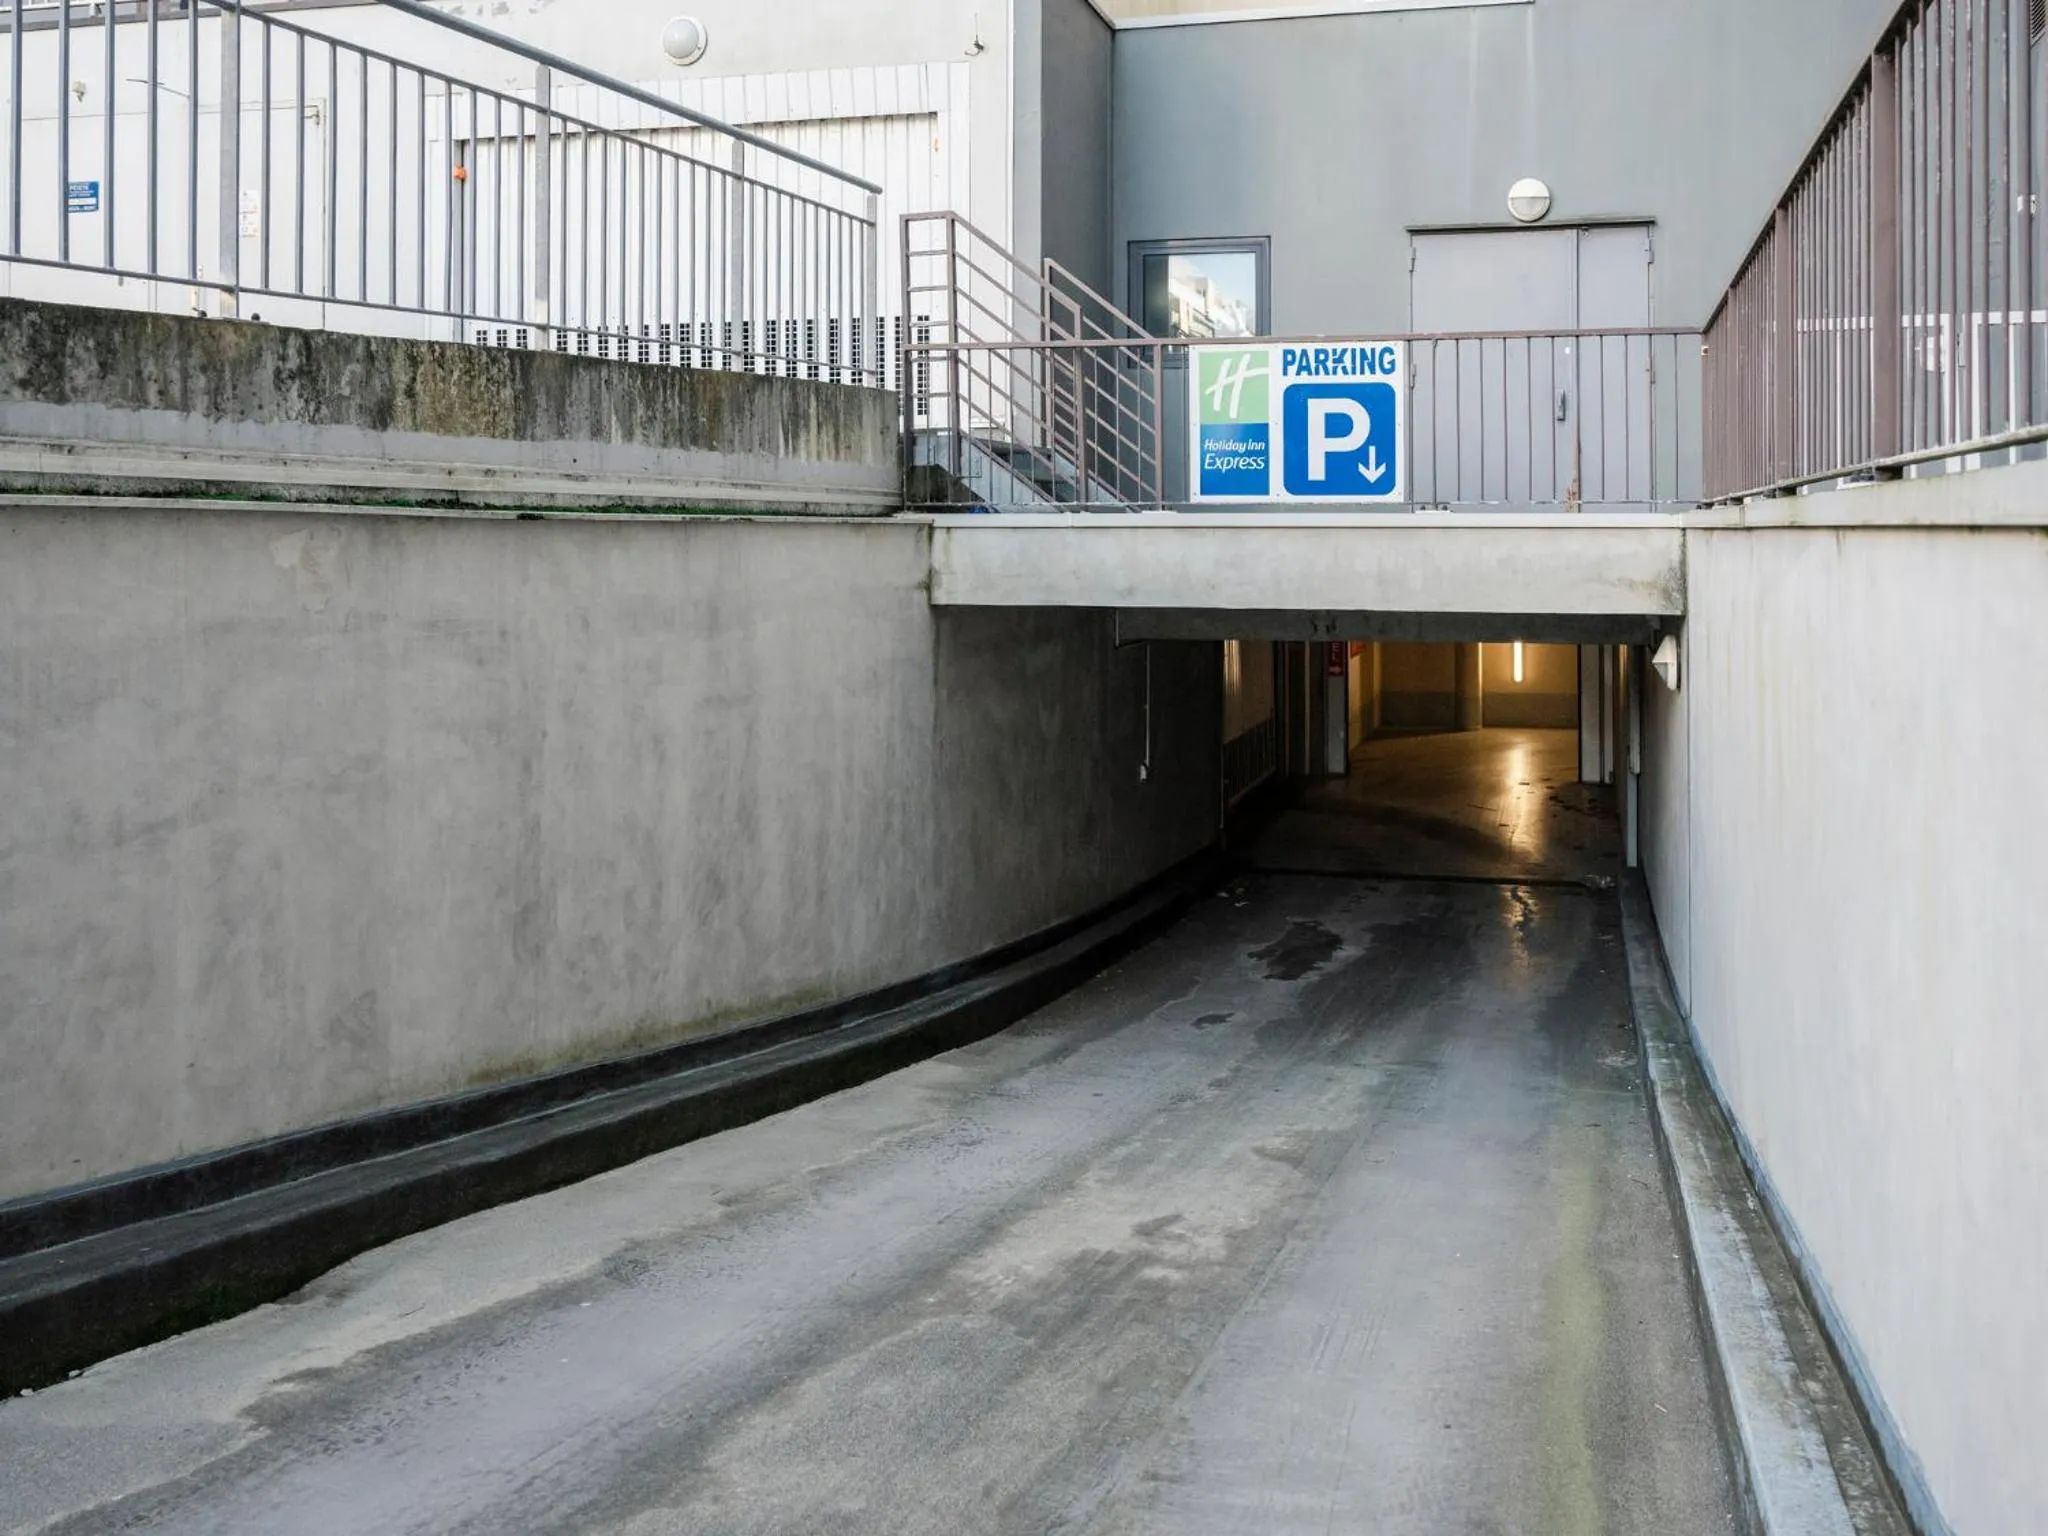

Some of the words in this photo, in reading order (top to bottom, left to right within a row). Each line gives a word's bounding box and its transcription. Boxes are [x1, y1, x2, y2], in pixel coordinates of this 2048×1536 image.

[1282, 347, 1396, 376] PARKING
[1204, 438, 1246, 453] Holiday
[1247, 438, 1265, 450] Inn
[1307, 397, 1371, 481] P
[1204, 453, 1265, 473] Express
